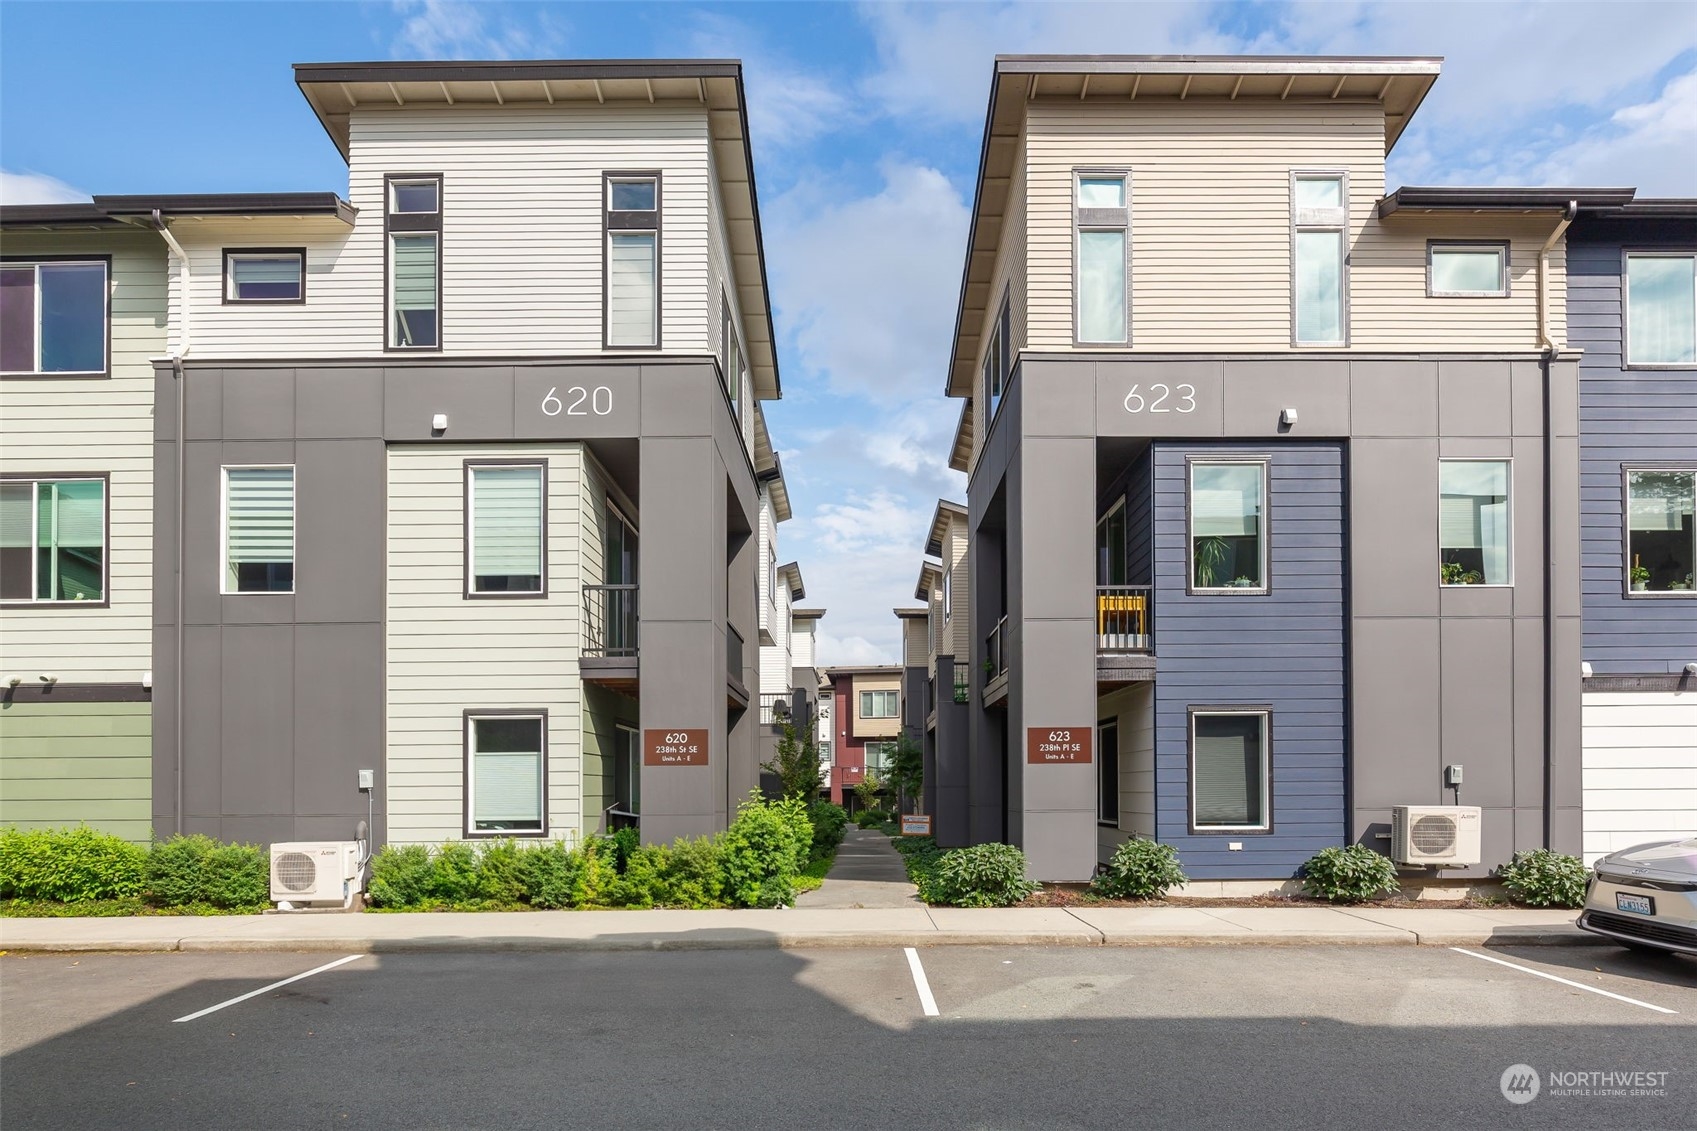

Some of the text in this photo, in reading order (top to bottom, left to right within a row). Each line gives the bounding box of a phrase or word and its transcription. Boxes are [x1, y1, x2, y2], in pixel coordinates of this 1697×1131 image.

[541, 386, 613, 416] 620
[1124, 383, 1196, 413] 623
[665, 733, 688, 743] 620
[1049, 731, 1070, 741] 623
